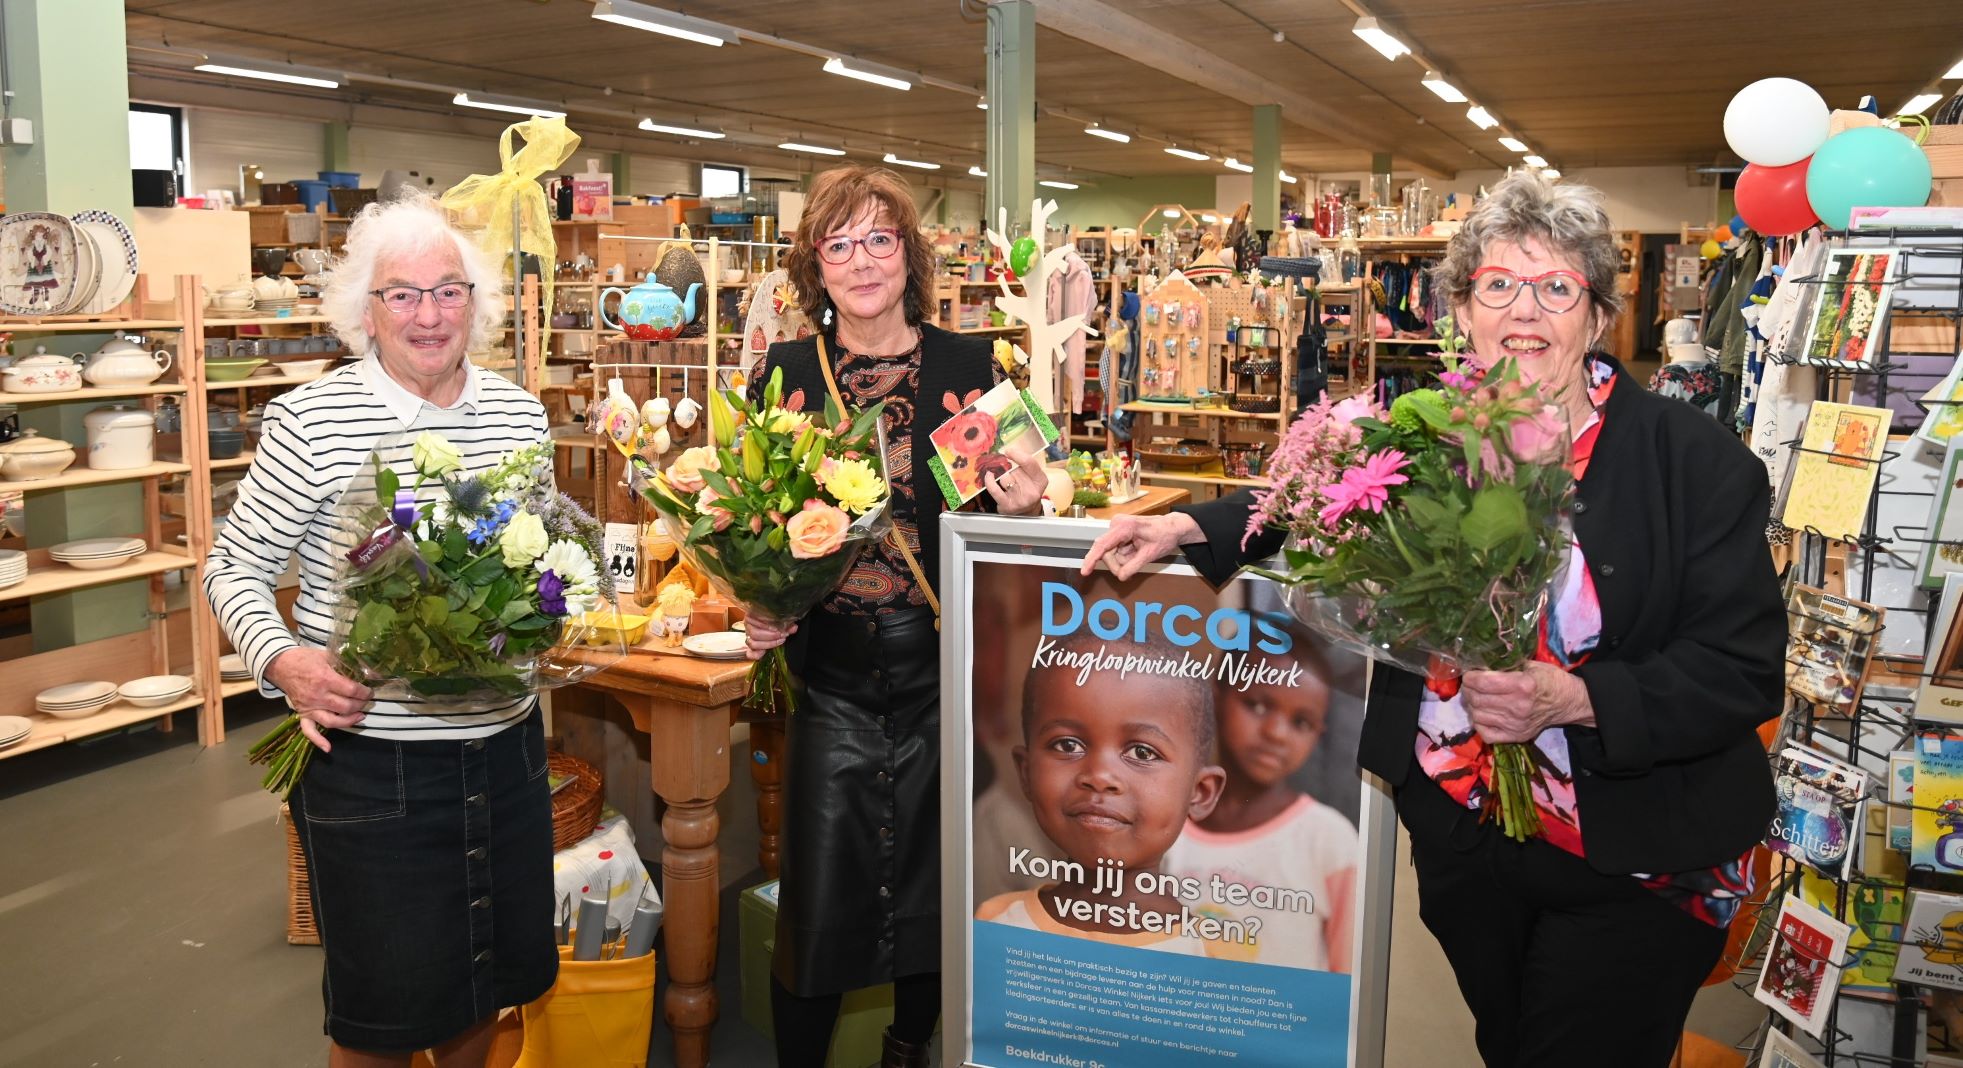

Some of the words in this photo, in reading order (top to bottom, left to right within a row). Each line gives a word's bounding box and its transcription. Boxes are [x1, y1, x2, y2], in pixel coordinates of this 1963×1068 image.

[1041, 581, 1293, 655] Dorcas
[1031, 635, 1216, 687] Kringloopwinkel
[1217, 652, 1304, 692] Nijkerk
[1771, 817, 1838, 859] Schitter
[1009, 846, 1085, 885] Kom
[1092, 857, 1124, 898] jij
[1134, 871, 1200, 900] ons
[1209, 874, 1314, 914] team
[1053, 895, 1263, 945] versterken?
[1006, 947, 1023, 956] Vind
[1023, 950, 1031, 959] jij
[1032, 951, 1045, 960] het
[1046, 953, 1062, 964] leuk
[1077, 960, 1114, 973] praktisch
[1115, 964, 1138, 978] bezig
[1139, 970, 1148, 979] te
[1149, 973, 1167, 983] zijn?
[1169, 974, 1182, 983] Wil
[1183, 976, 1191, 986] jij
[1191, 977, 1200, 987] je
[1202, 980, 1228, 990] gaven
[1241, 984, 1276, 996] talenten
[1006, 958, 1036, 969] inzetten
[1037, 963, 1047, 971] en
[1049, 965, 1063, 973] een
[1064, 966, 1097, 981] bijdrage
[1098, 974, 1130, 986] leveren
[1128, 981, 1144, 989] aan
[1146, 982, 1157, 991] de
[1158, 985, 1176, 994] hulp
[1177, 988, 1196, 996] voor
[1197, 991, 1230, 1000] mensen
[1231, 994, 1239, 1002] in
[1240, 996, 1266, 1005] nood?
[1268, 999, 1284, 1008] Dan
[1006, 969, 1065, 985] vrijwilligerswerk
[1075, 981, 1102, 993] Dorcas
[1103, 986, 1129, 997] Winkel
[1130, 991, 1156, 1002] Nijkerk
[1158, 995, 1173, 1005] iets
[1211, 1002, 1225, 1012] Wij
[1226, 1004, 1255, 1015] bieden
[1256, 1009, 1270, 1018] jou
[1271, 1012, 1287, 1020] een
[1289, 1012, 1308, 1023] fijne
[1925, 970, 1955, 981] bent
[1006, 980, 1042, 991] werksfeer
[1043, 985, 1051, 993] in
[1052, 988, 1067, 996] een
[1068, 990, 1098, 1004] gezellig
[1099, 997, 1122, 1007] team.
[1124, 1001, 1139, 1010] Van
[1140, 1002, 1217, 1022] kassamedewerkers
[1219, 1015, 1231, 1024] tot
[1233, 1017, 1278, 1030] chauffeurs
[1279, 1023, 1292, 1032] tot
[1112, 1009, 1130, 1018] alles
[1142, 1014, 1162, 1024] doen
[1184, 1022, 1204, 1031] rond
[1205, 1024, 1217, 1033] de
[1218, 1027, 1246, 1037] winkel.
[1005, 1021, 1119, 1048] dorcaswinkelnijkerk@dorcas.nl
[1006, 1010, 1028, 1022] Vraag
[1049, 1019, 1073, 1029] winkel
[1089, 1026, 1130, 1040] informatie
[1141, 1036, 1161, 1046] stuur
[1163, 1040, 1178, 1048] een
[1179, 1041, 1217, 1055] berichtje
[1218, 1050, 1238, 1058] naar
[1006, 1045, 1086, 1068] Boekdrukker
